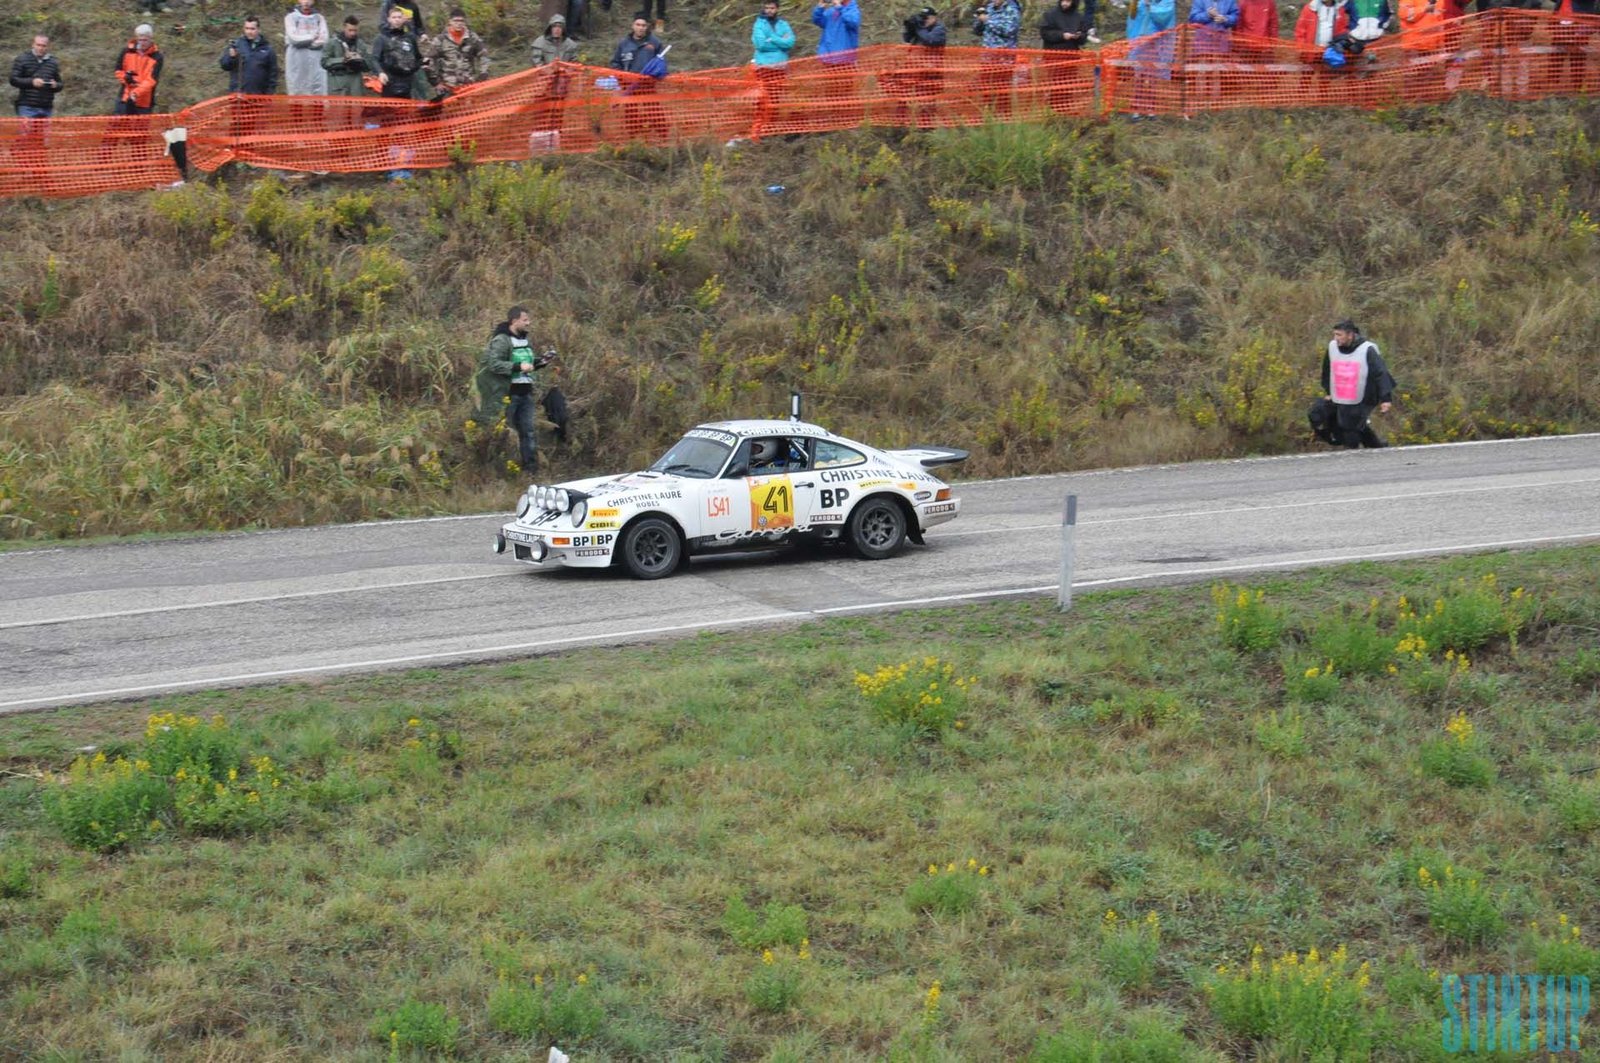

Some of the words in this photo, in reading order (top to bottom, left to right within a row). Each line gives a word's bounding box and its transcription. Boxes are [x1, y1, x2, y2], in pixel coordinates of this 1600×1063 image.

[820, 470, 897, 483] CHRISTINE
[607, 492, 654, 507] CHRISTINE
[654, 490, 682, 500] LAURE
[707, 496, 730, 517] LS41
[763, 485, 789, 514] 41
[820, 488, 850, 509] BP
[529, 510, 562, 526] BP
[573, 536, 590, 547] BP
[597, 534, 613, 545] BP
